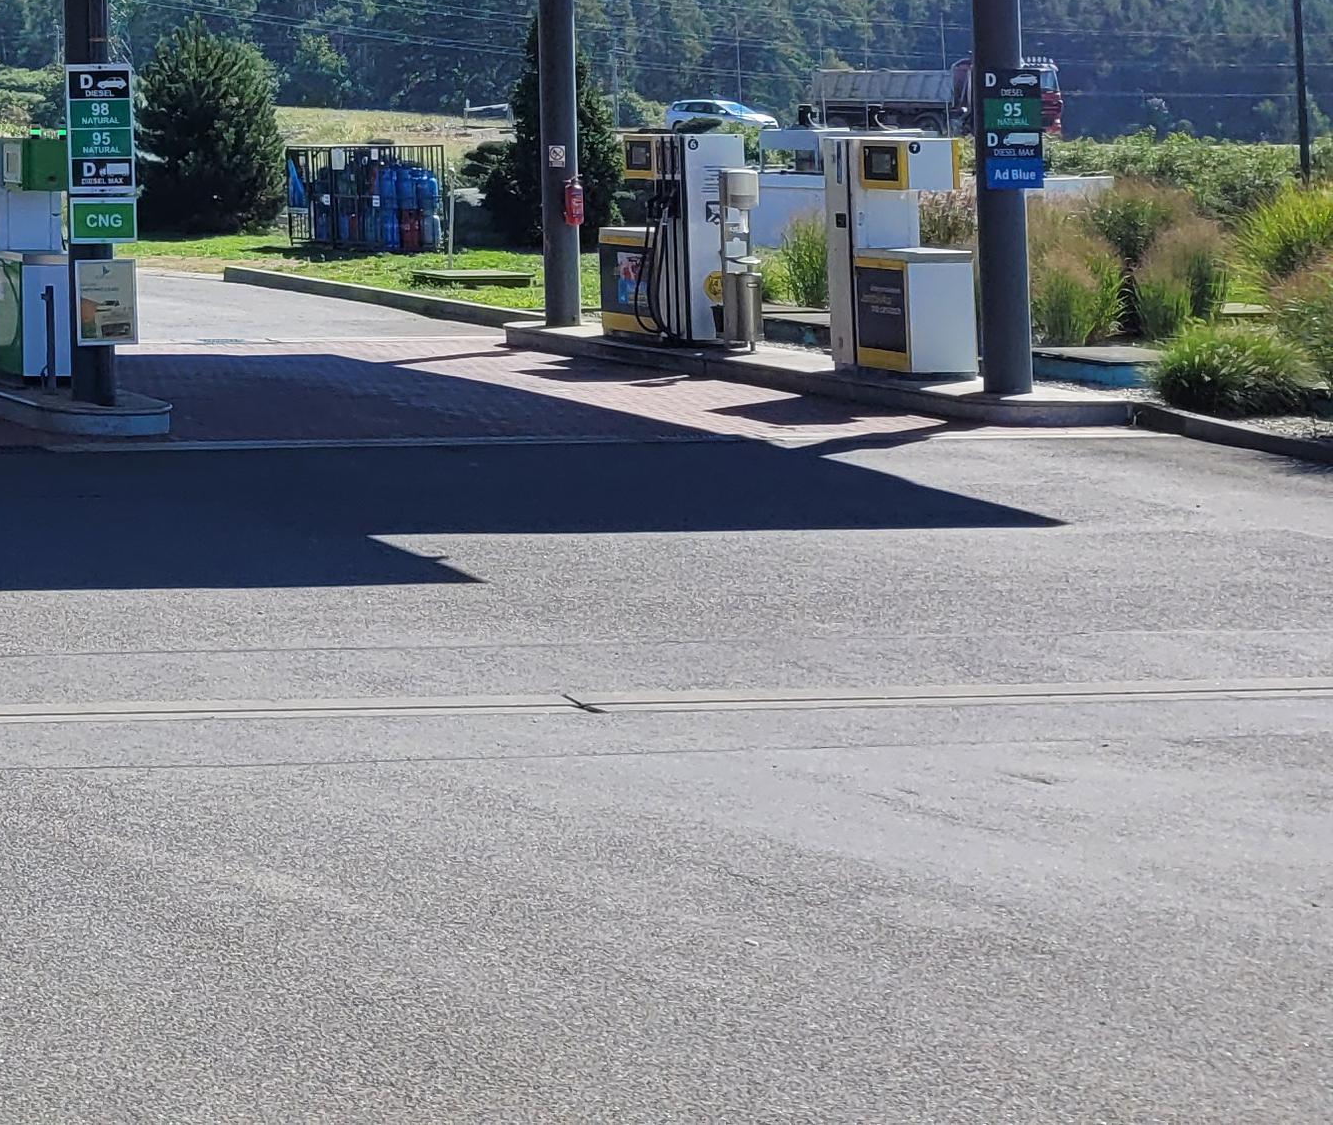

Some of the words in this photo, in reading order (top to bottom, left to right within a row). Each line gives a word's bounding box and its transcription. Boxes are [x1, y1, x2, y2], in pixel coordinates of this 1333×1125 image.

[79, 74, 94, 90] D
[985, 72, 997, 87] D
[84, 89, 116, 97] DIESEL
[1001, 88, 1024, 97] DIESEL
[91, 102, 110, 116] 98
[1003, 102, 1022, 117] 95
[81, 116, 121, 125] NATURAL
[997, 117, 1030, 126] NATURAL
[92, 131, 111, 145] 95
[987, 132, 999, 147] D
[82, 145, 121, 154] NATURAL
[993, 148, 1017, 156] DIESEL
[1018, 148, 1035, 156] MAX
[82, 161, 96, 177] D
[994, 168, 1009, 180] Ad
[1011, 168, 1036, 180] Blue
[81, 177, 107, 185] DIESEL
[107, 177, 124, 185] MAX
[86, 213, 123, 228] CNG
